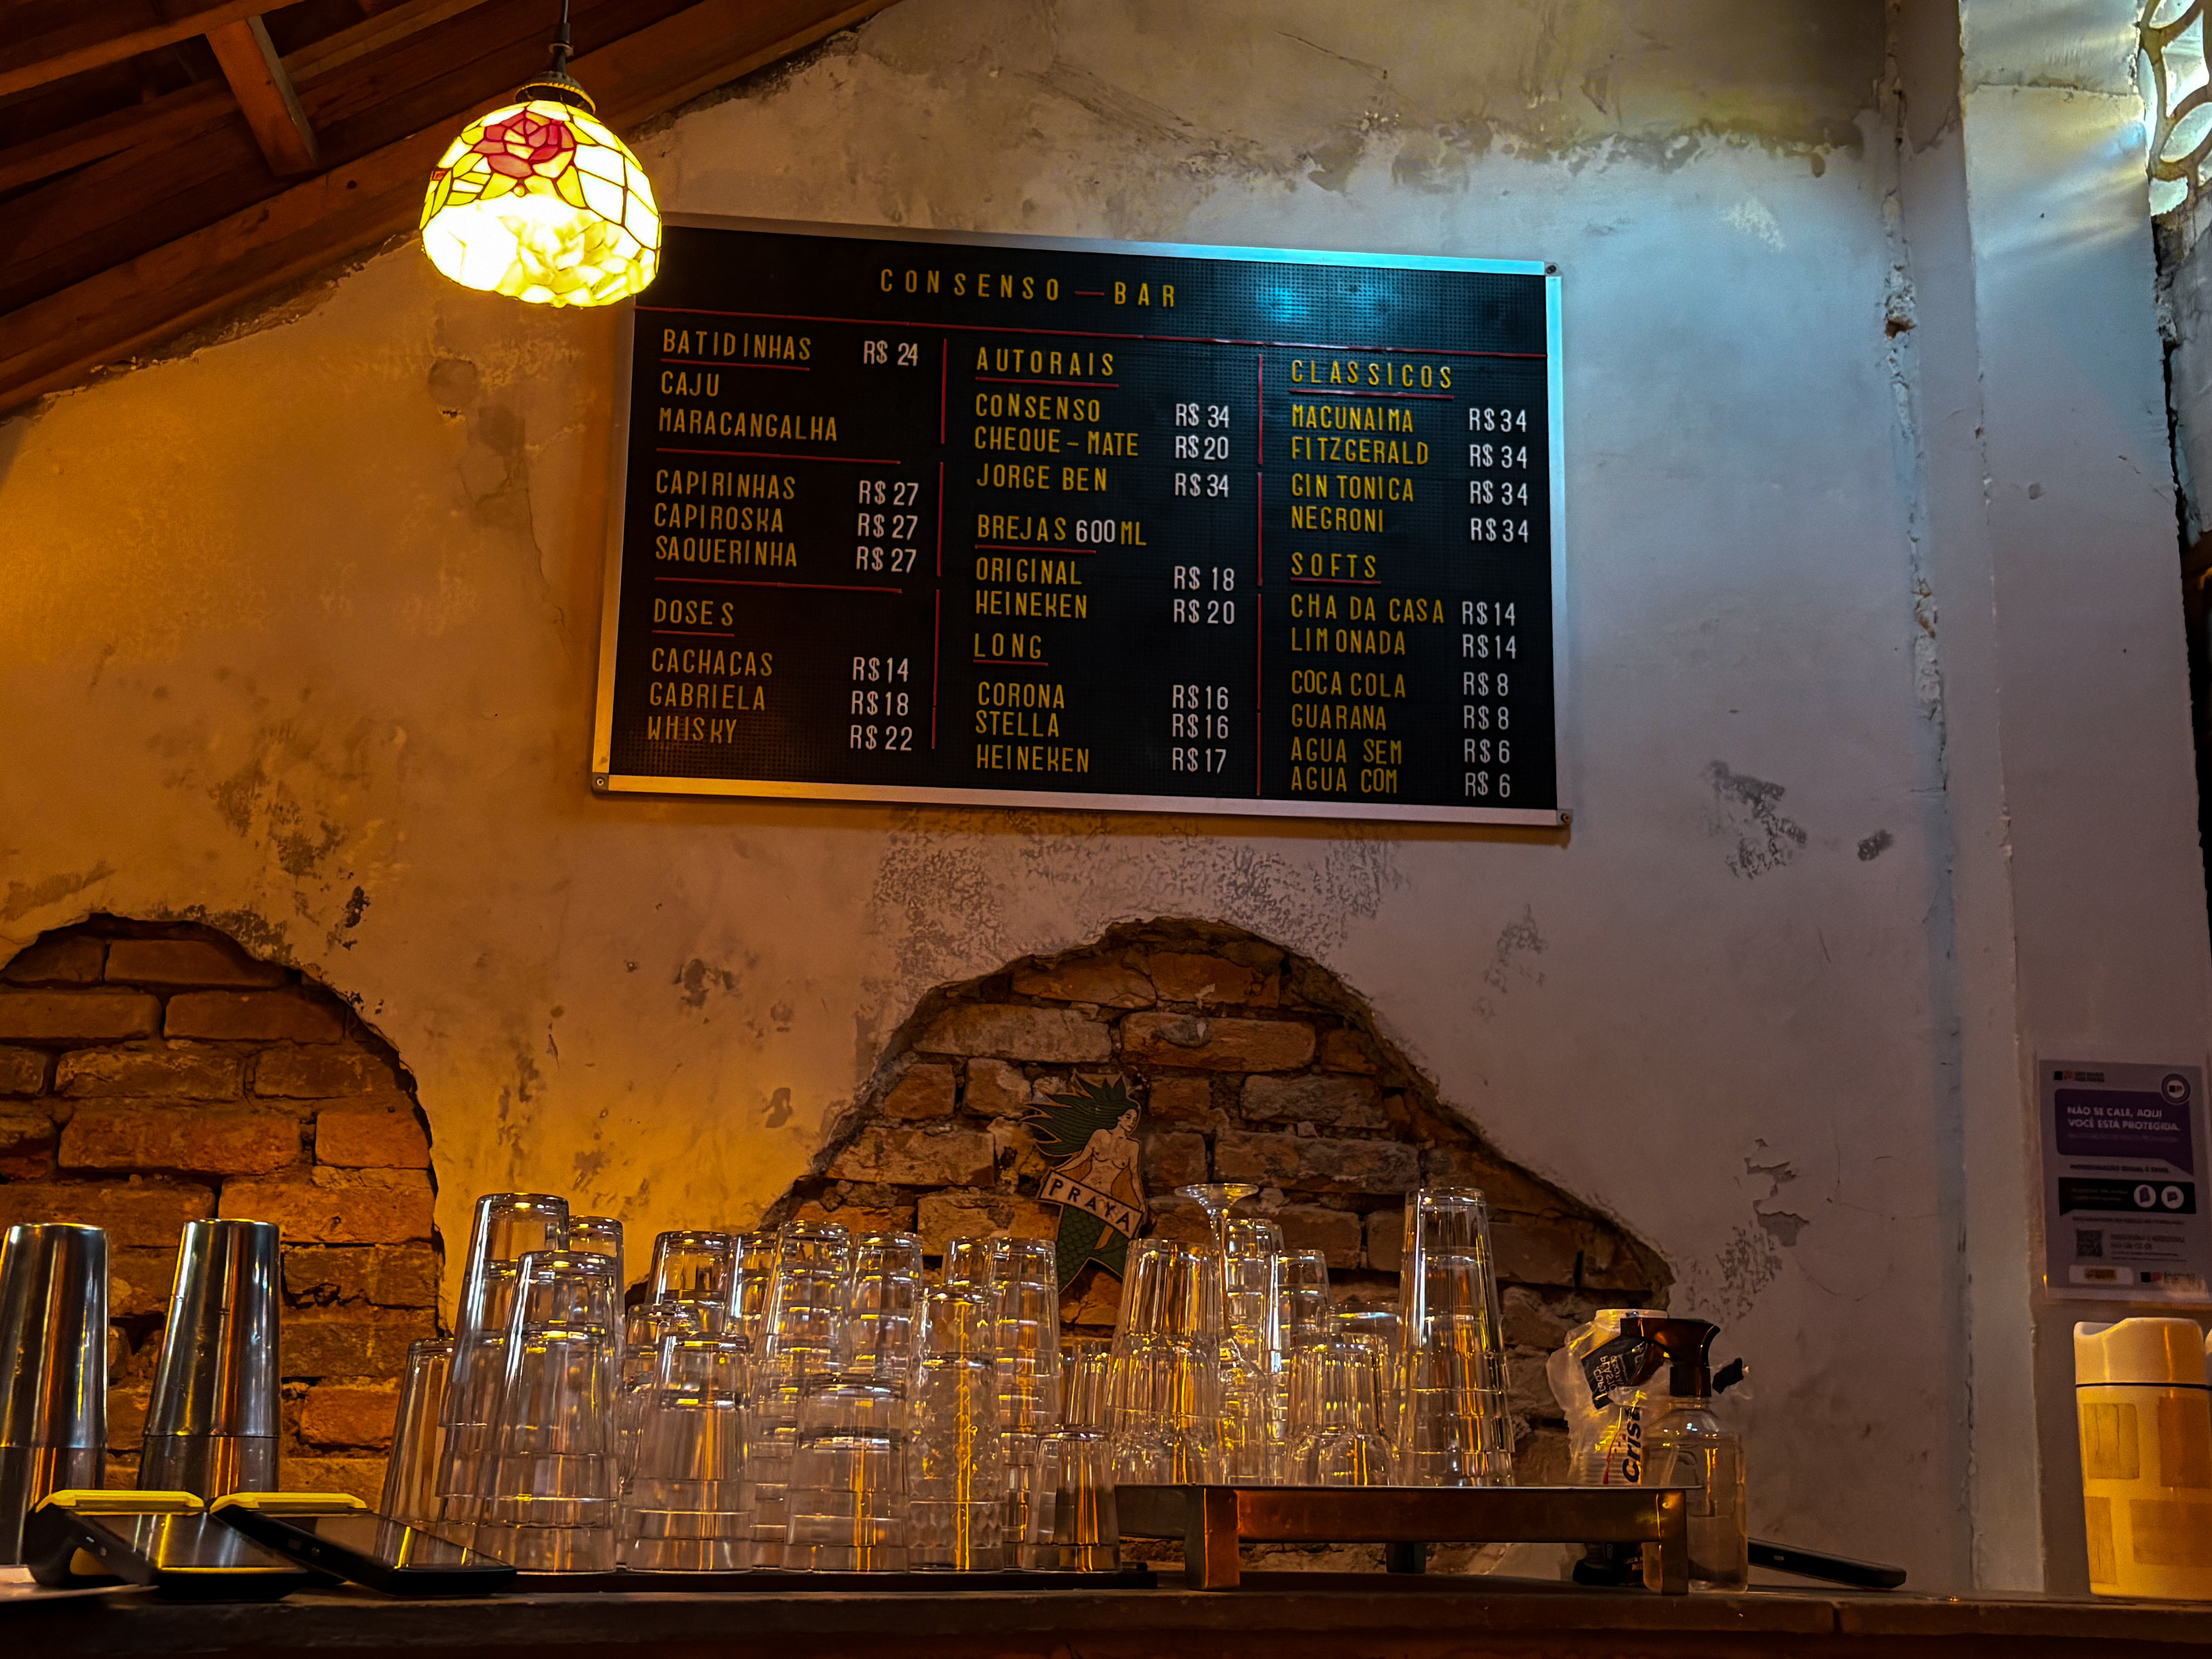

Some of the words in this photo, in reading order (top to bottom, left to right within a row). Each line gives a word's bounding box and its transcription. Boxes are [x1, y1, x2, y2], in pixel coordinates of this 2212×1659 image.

[881, 269, 1059, 301] CONSENSO
[1114, 281, 1174, 307] BAR
[663, 328, 811, 360] BATIDINHAS
[976, 346, 1113, 376] AUTORAIS
[1291, 359, 1451, 389] CLASSICOS
[661, 370, 719, 397] CAJU
[976, 393, 1100, 422] CONSENSO
[1292, 404, 1413, 433] MACUNAIMA
[659, 407, 837, 441] MARACANGALHA
[1291, 436, 1428, 465] FITZGERALD
[656, 469, 795, 500] CAPIRINHAS
[976, 463, 1050, 490] JORGE
[1062, 467, 1106, 491] BEN
[654, 502, 783, 533] CAPIROSKA
[978, 514, 1066, 542] BREJAS
[1291, 505, 1383, 533] NEGRONI
[656, 535, 797, 567] SAQUERINHA
[1291, 552, 1376, 578] SOFTS
[976, 557, 1082, 585] ORIGINAL
[976, 589, 1087, 619] HEINEKEN
[1291, 593, 1337, 619] CHA
[1350, 596, 1376, 621] DA
[1389, 598, 1444, 624] CASA
[974, 632, 1041, 659] LONG
[1291, 626, 1405, 655] LIMONADA
[650, 682, 765, 711] GABRIELA
[978, 681, 1065, 709] CORONA
[1291, 669, 1342, 696] COCA
[1351, 672, 1406, 698] COLA
[647, 715, 737, 744] WHISKY
[975, 709, 1059, 737] STELLA
[1291, 703, 1386, 731] GUARANA
[977, 744, 1089, 773] HEINEKEN
[1291, 736, 1347, 763] AGUA
[1363, 738, 1402, 765] SEM
[1291, 766, 1347, 792] AGUA
[1360, 767, 1397, 794] COM
[1048, 1179, 1131, 1232] PRAYA
